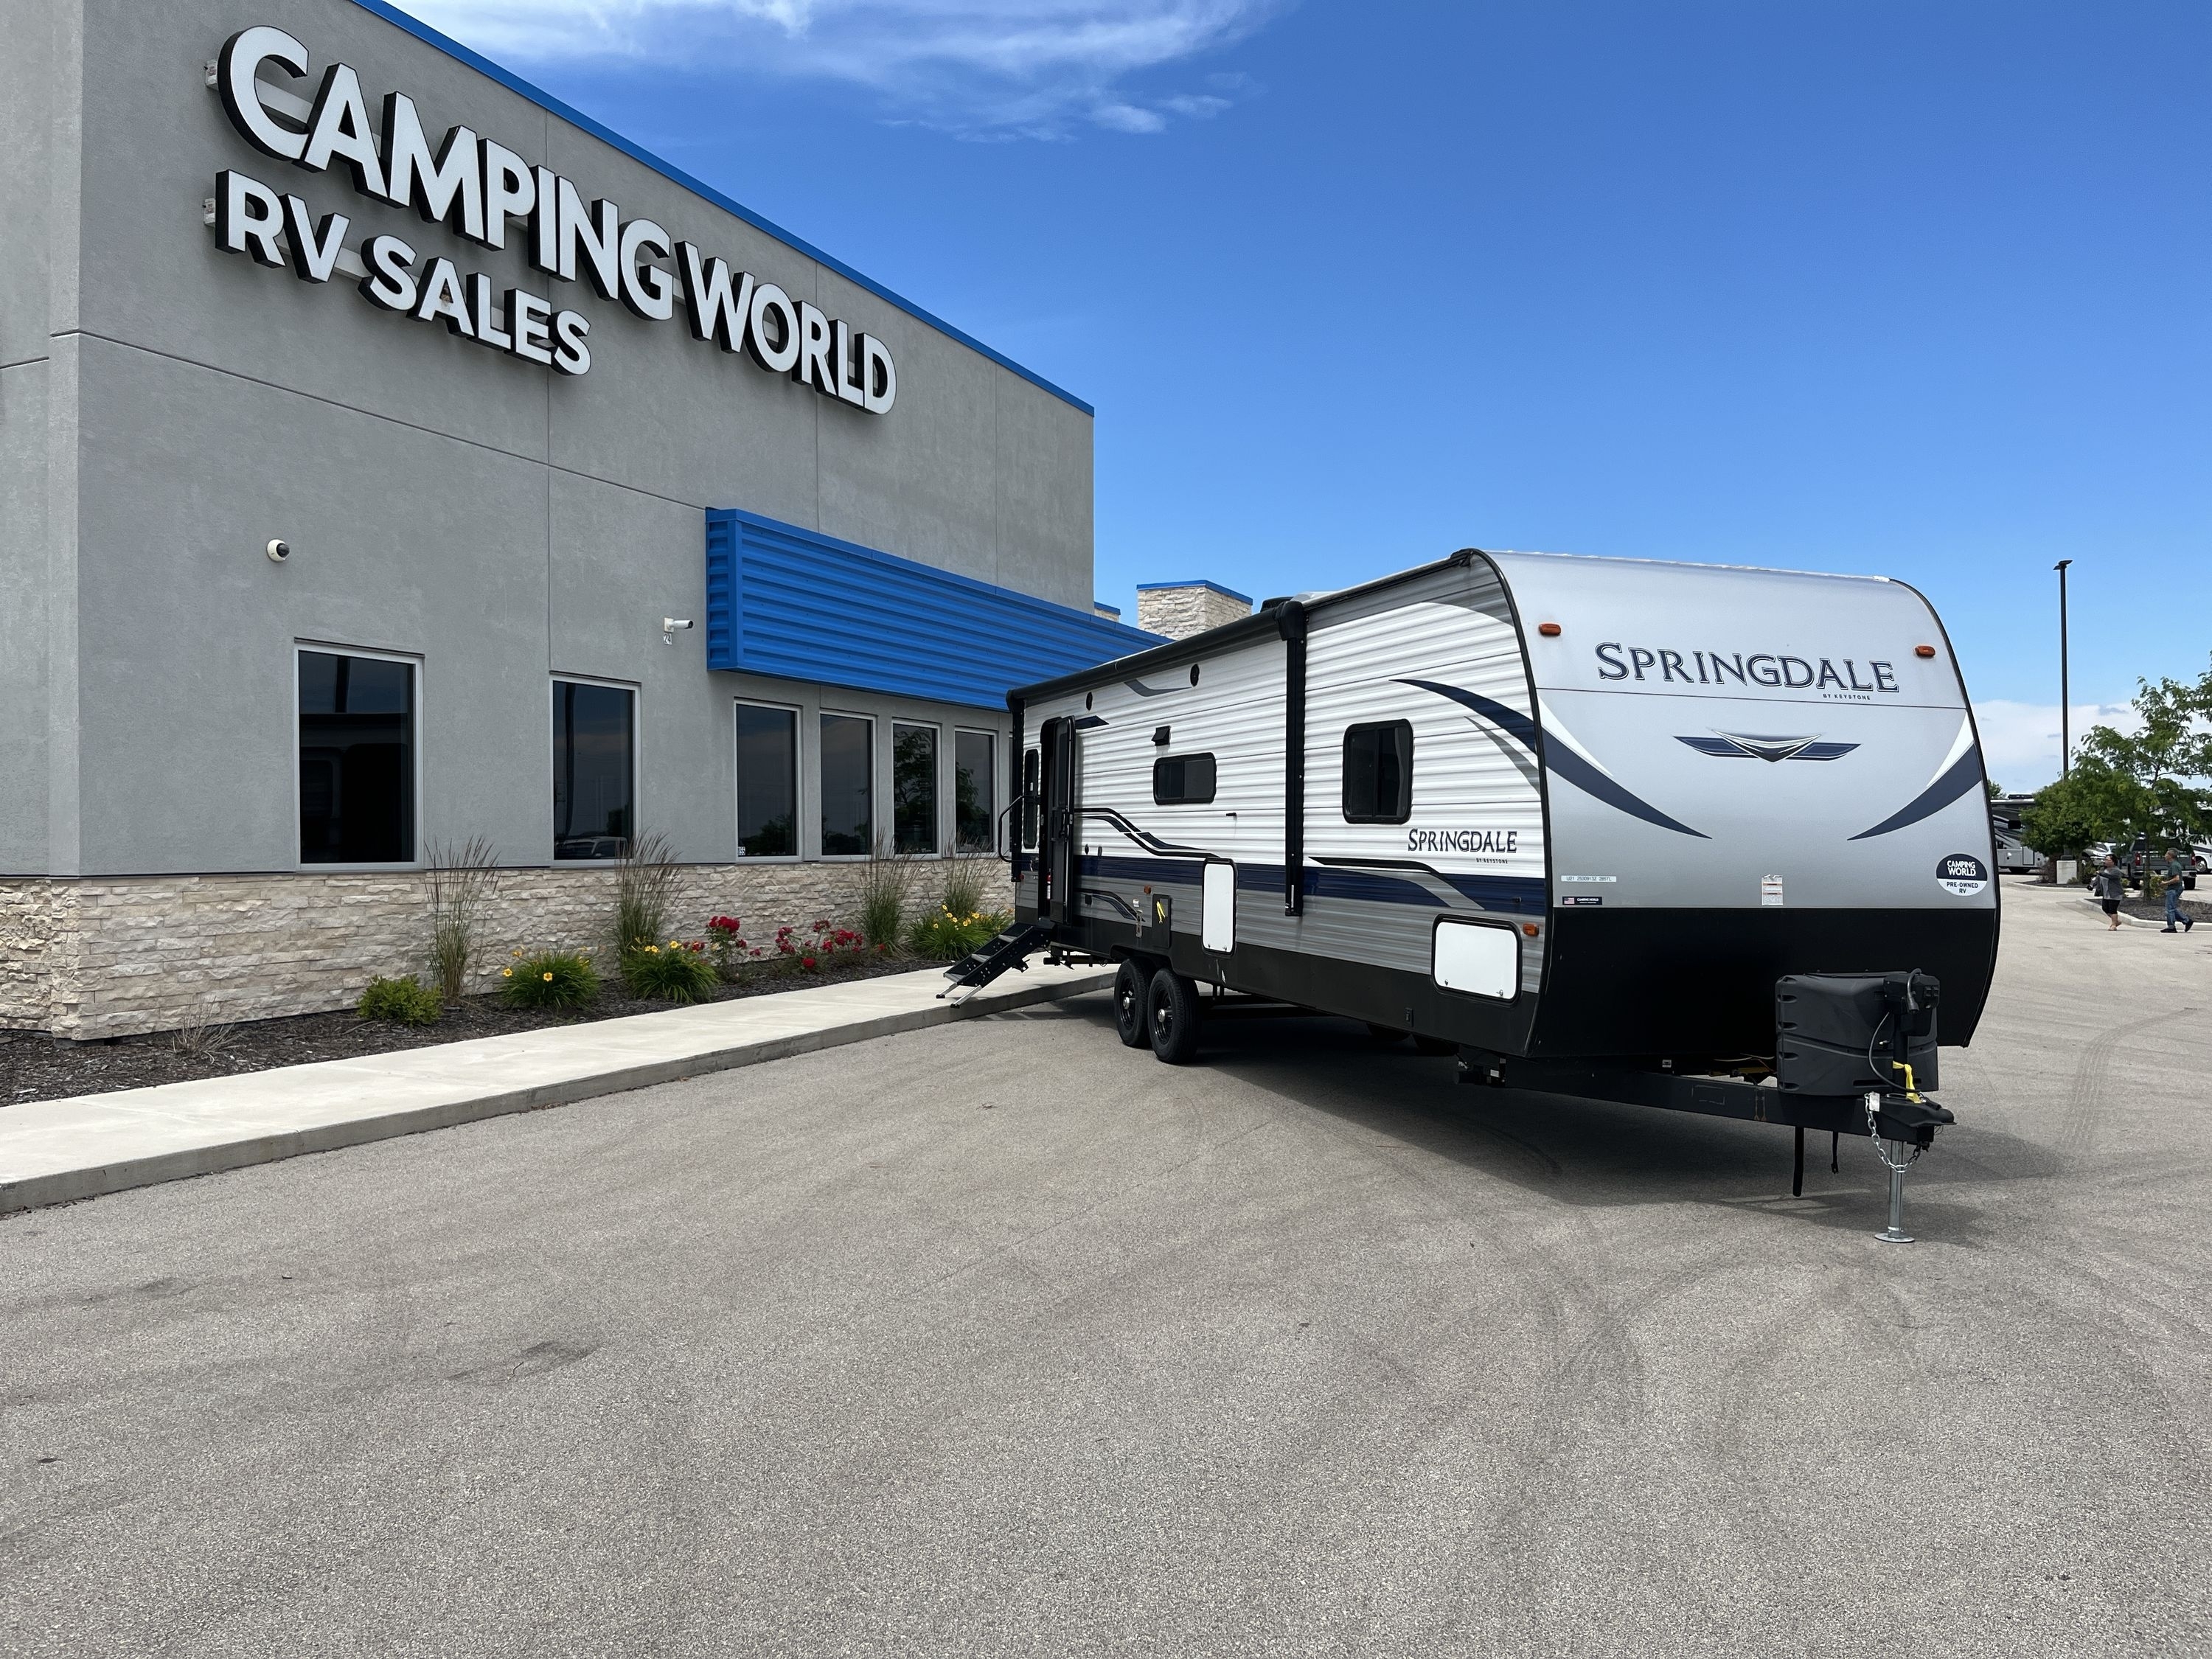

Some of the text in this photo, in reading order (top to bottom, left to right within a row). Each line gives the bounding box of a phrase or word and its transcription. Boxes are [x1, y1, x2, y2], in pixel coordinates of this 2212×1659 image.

[217, 25, 897, 415] CAMPING WORLD
[215, 169, 591, 376] RV SALES
[1594, 641, 1900, 693] SPRINGDALE
[1408, 827, 1517, 853] SPRINGDALE
[1947, 860, 1976, 869] CAMPING
[1947, 867, 1977, 877] WORLD
